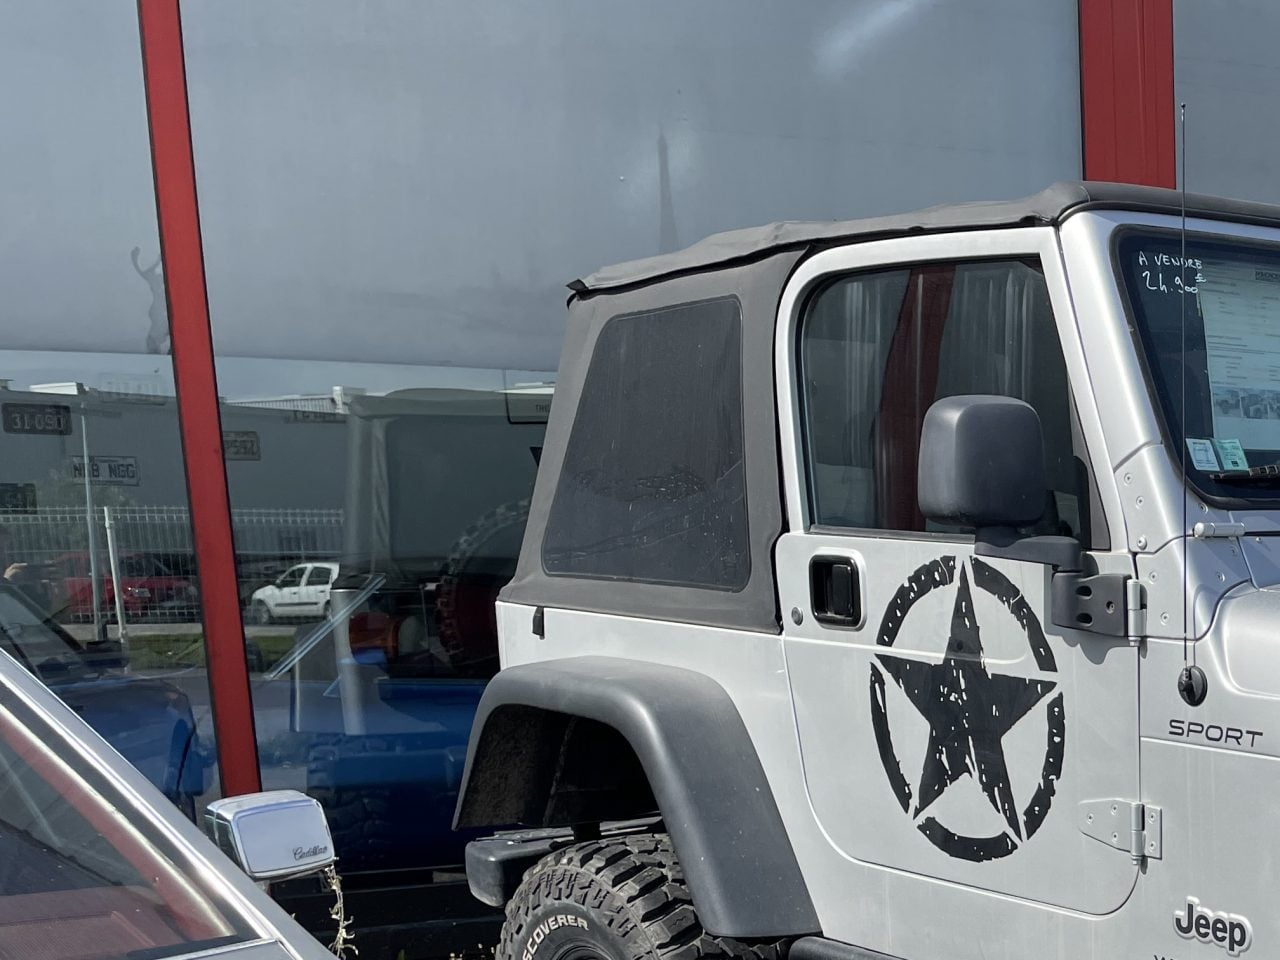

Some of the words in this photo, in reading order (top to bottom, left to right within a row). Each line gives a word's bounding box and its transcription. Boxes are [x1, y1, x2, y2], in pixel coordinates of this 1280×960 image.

[1138, 251, 1148, 266] A
[1154, 253, 1203, 269] VENDRE
[1168, 719, 1264, 747] SPORT
[293, 845, 328, 861] Cadillac
[1174, 902, 1248, 952] Jeep
